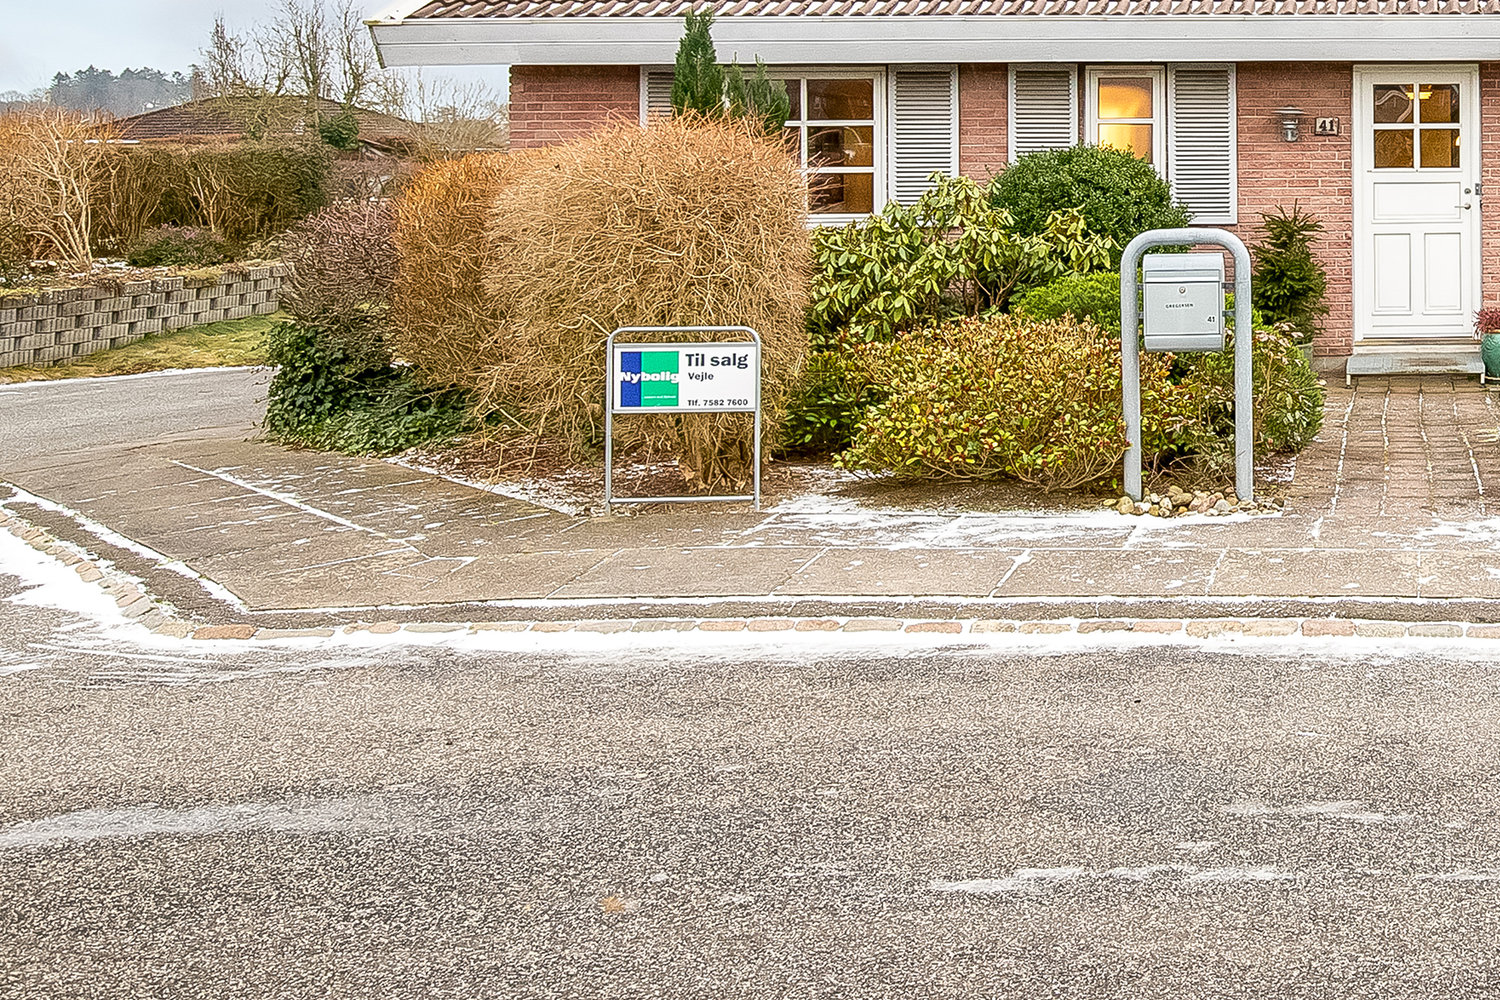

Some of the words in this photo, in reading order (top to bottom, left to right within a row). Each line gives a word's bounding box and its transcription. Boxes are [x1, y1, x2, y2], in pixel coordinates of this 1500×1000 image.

[1319, 119, 1335, 131] 41
[685, 353, 705, 367] Til
[710, 353, 749, 370] salg
[620, 371, 680, 384] Nybolig
[688, 372, 714, 382] Vejle
